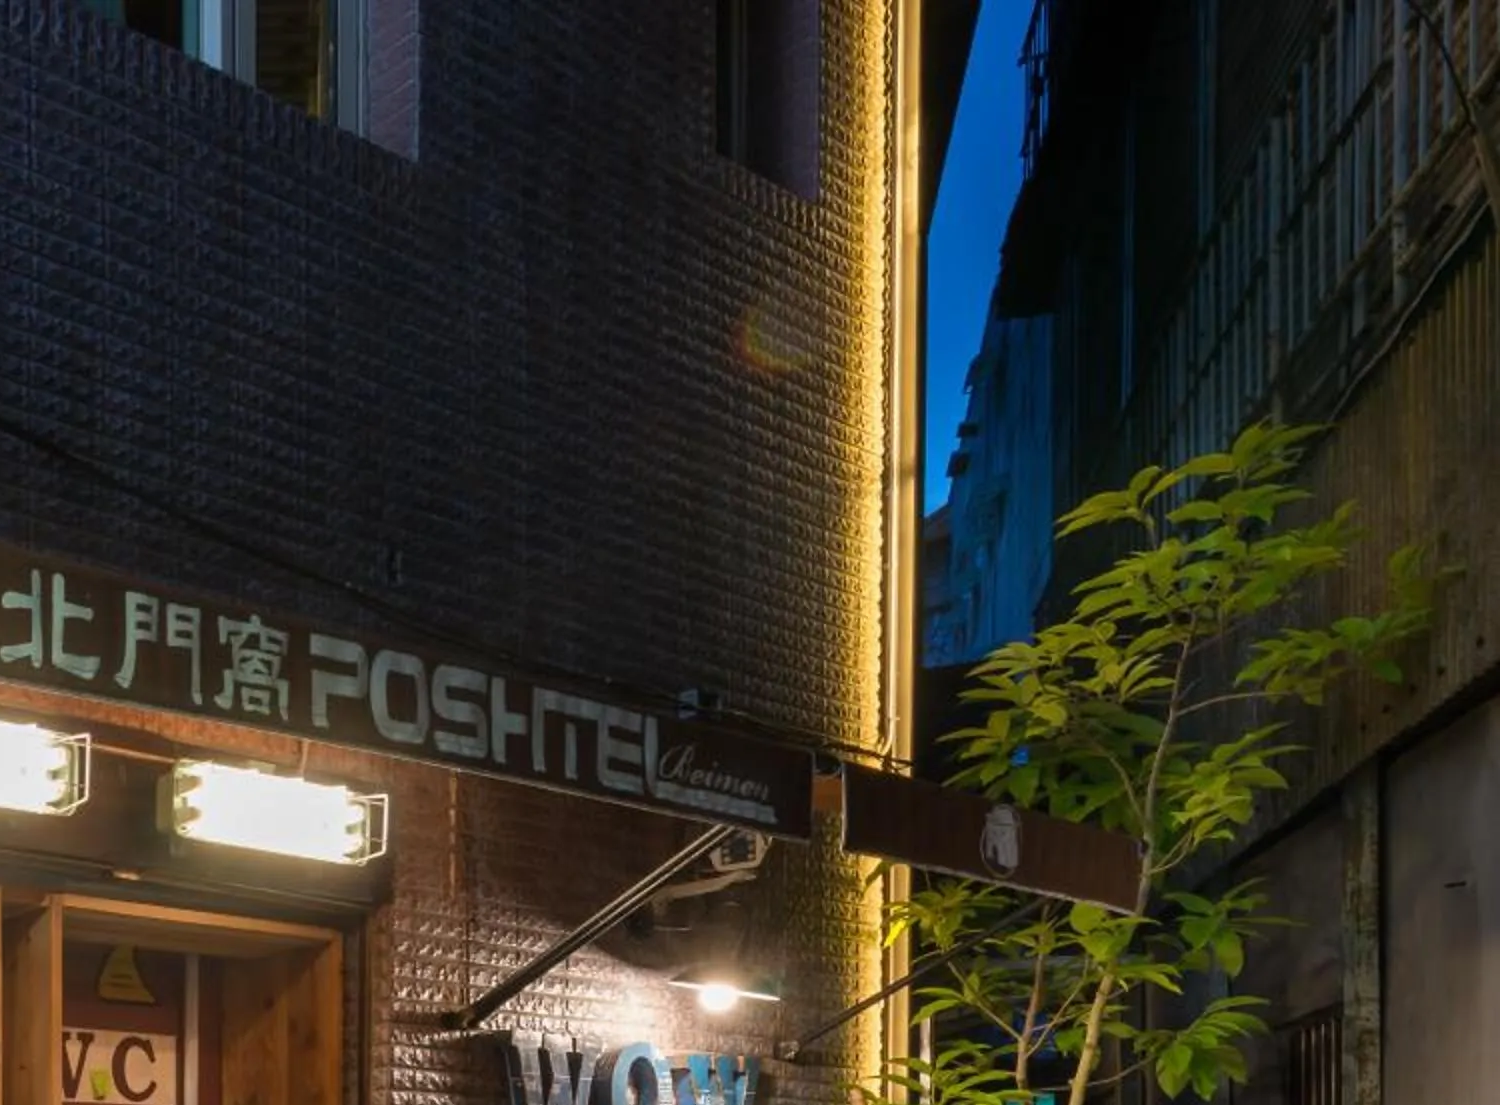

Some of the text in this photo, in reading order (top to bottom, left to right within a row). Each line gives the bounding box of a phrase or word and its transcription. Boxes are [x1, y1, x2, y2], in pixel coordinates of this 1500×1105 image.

[0, 569, 289, 721] 北門窩
[310, 633, 778, 824] POSHTEL
